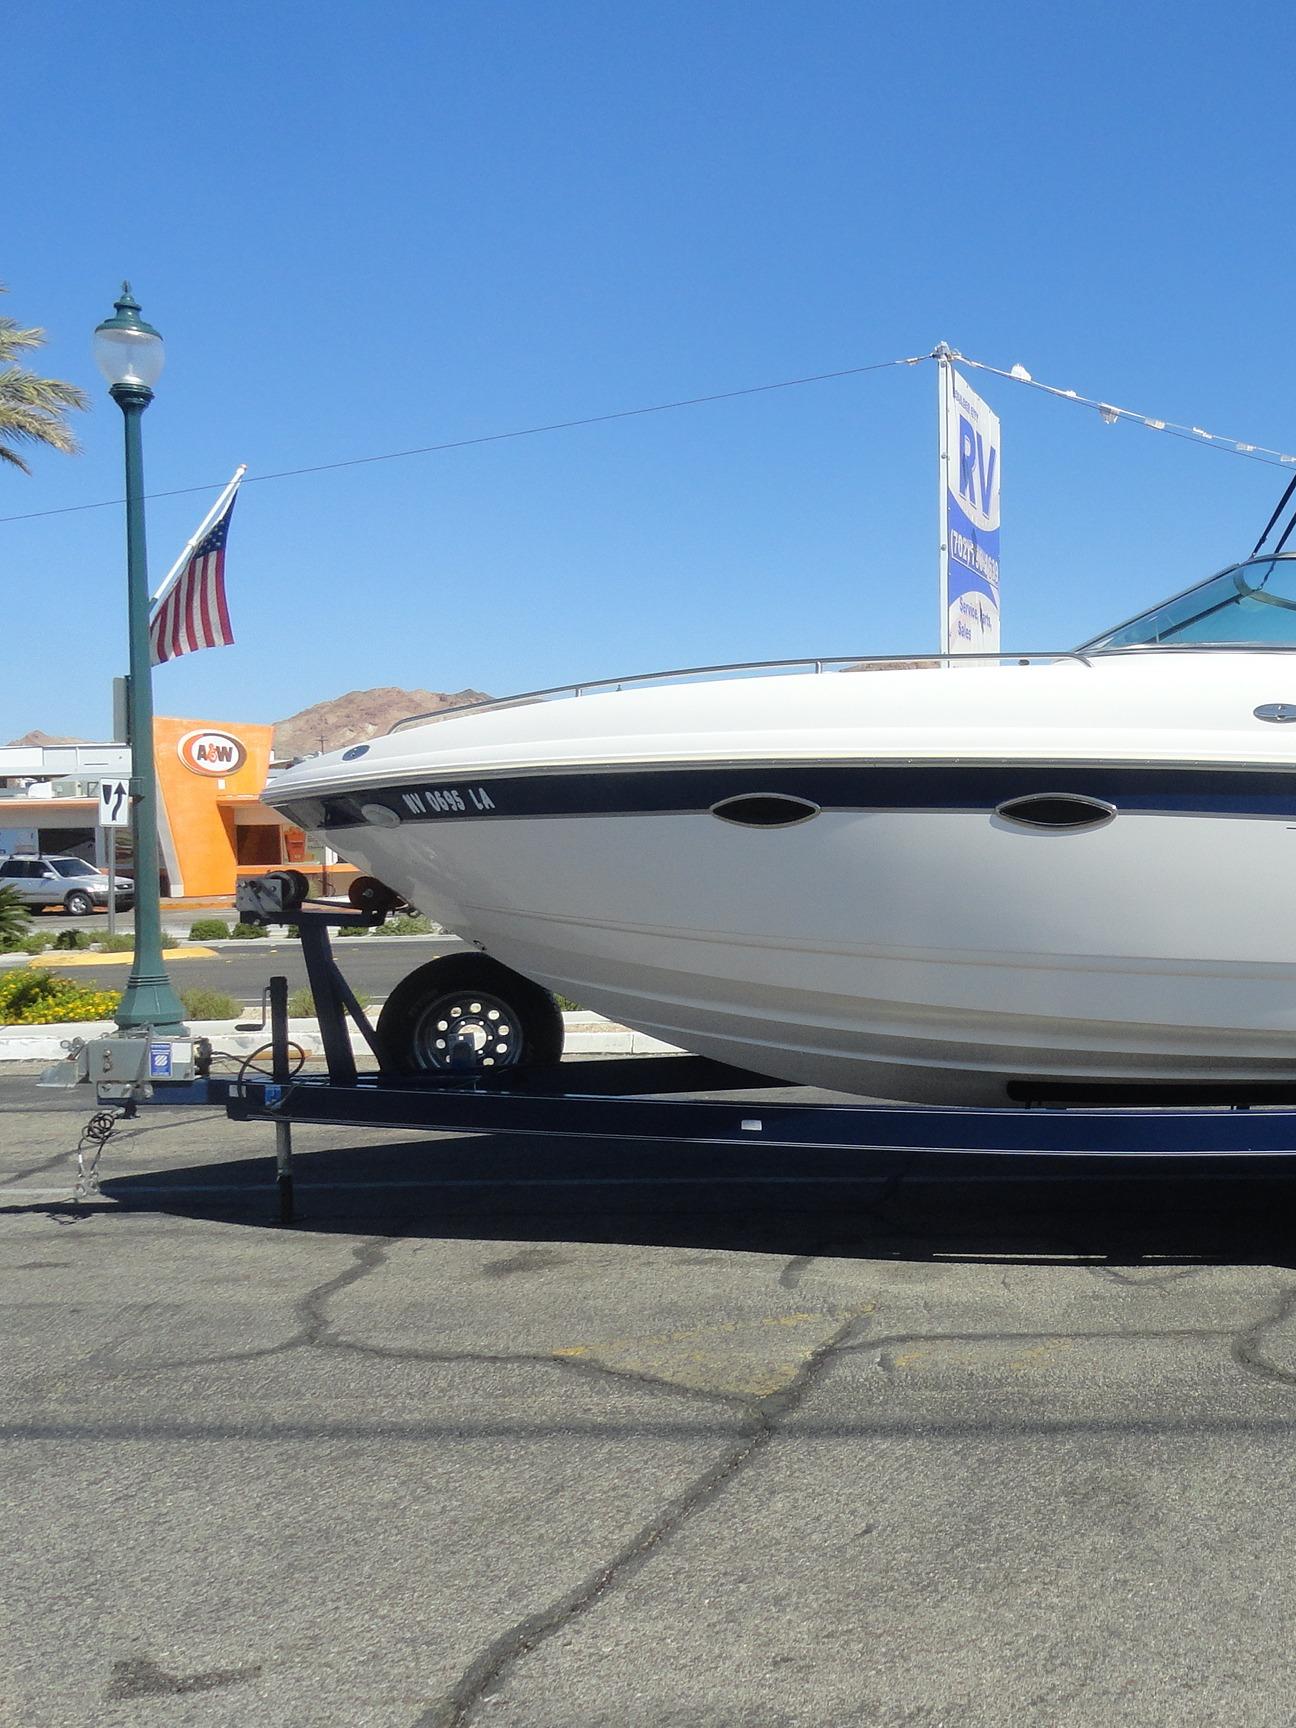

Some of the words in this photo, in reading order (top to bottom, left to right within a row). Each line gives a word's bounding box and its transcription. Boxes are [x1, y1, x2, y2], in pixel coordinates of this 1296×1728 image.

[958, 413, 996, 520] RV
[197, 743, 233, 763] A&W
[402, 792, 427, 815] NV
[424, 789, 466, 812] 0695
[468, 787, 496, 810] LA
